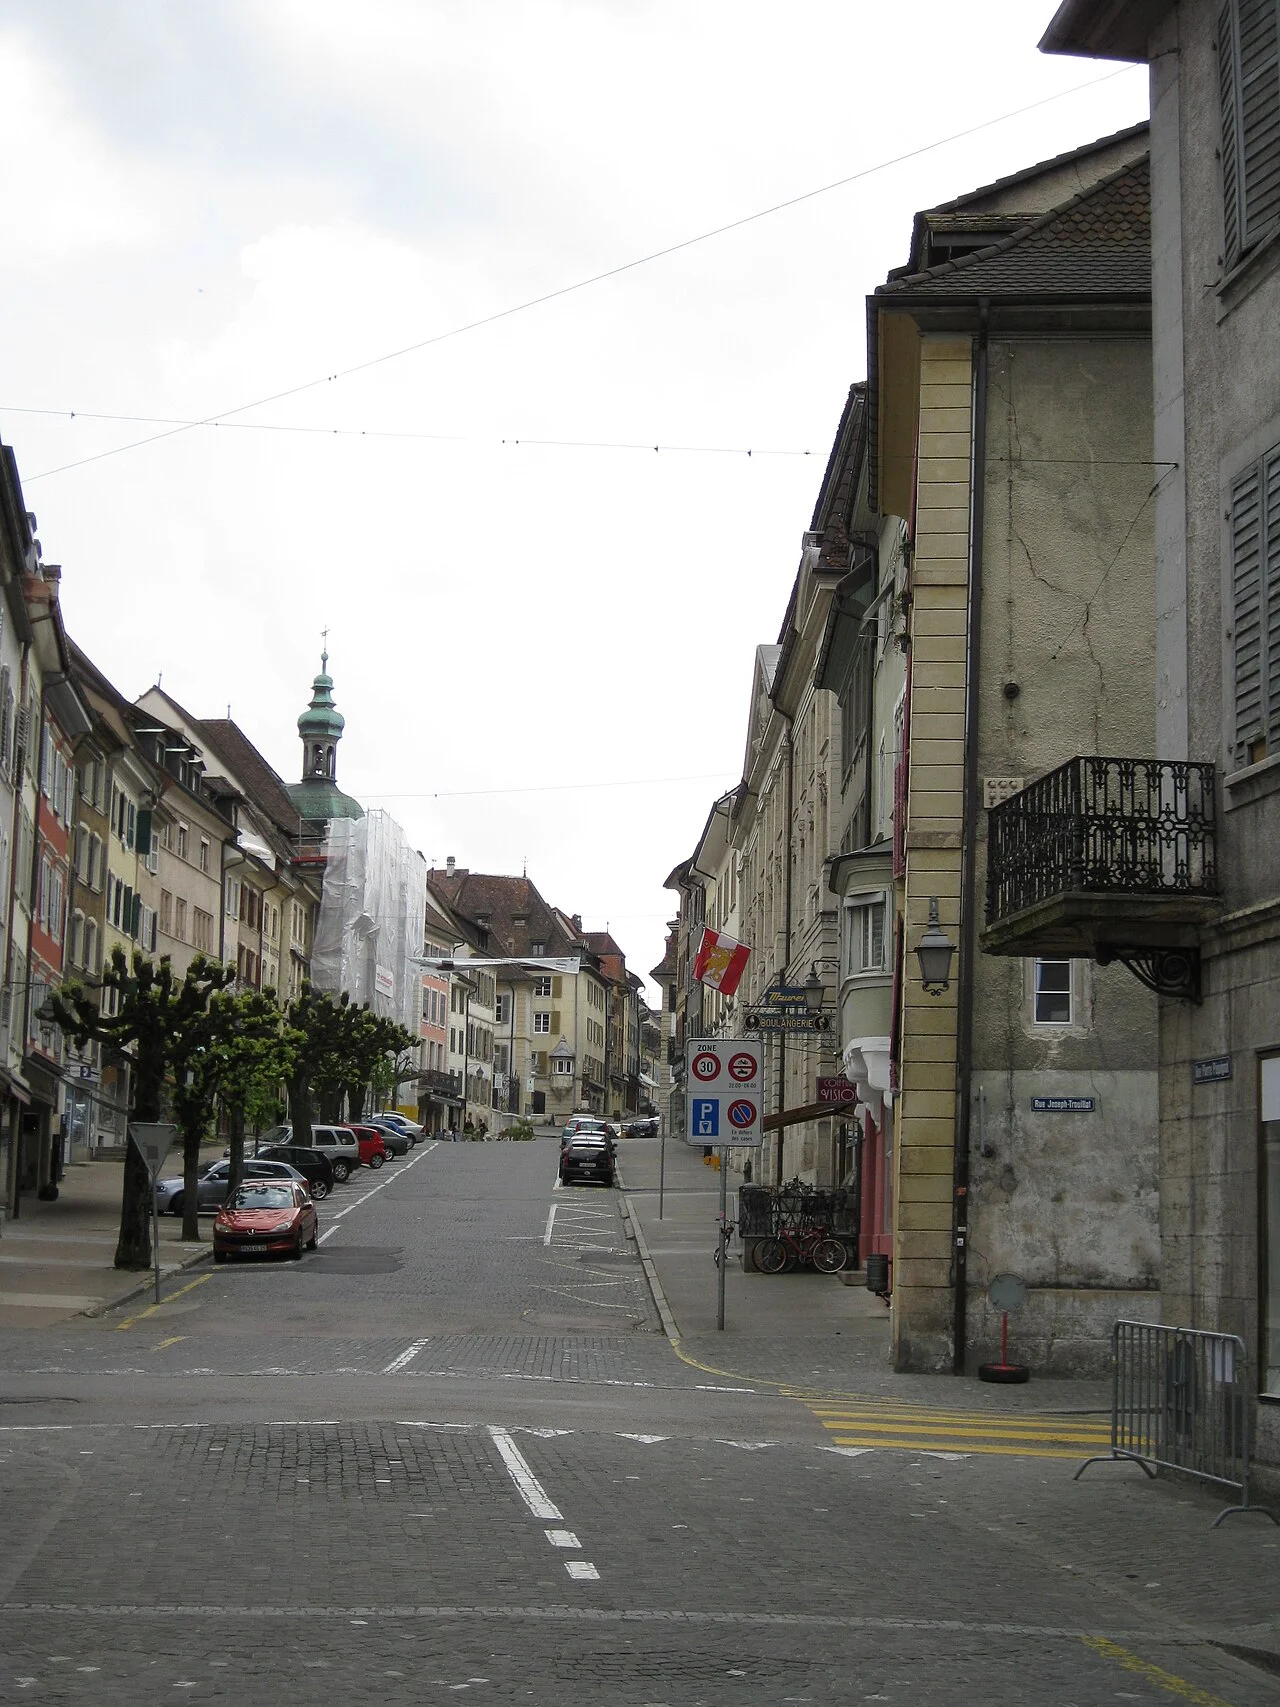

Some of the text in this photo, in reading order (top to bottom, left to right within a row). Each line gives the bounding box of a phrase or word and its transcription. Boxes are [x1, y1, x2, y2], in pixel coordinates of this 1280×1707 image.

[760, 1019, 814, 1028] BOULANGERIE
[697, 1044, 717, 1052] ZONE
[700, 1061, 713, 1073] 30
[1034, 1099, 1046, 1108] Rue
[702, 1103, 713, 1120] P
